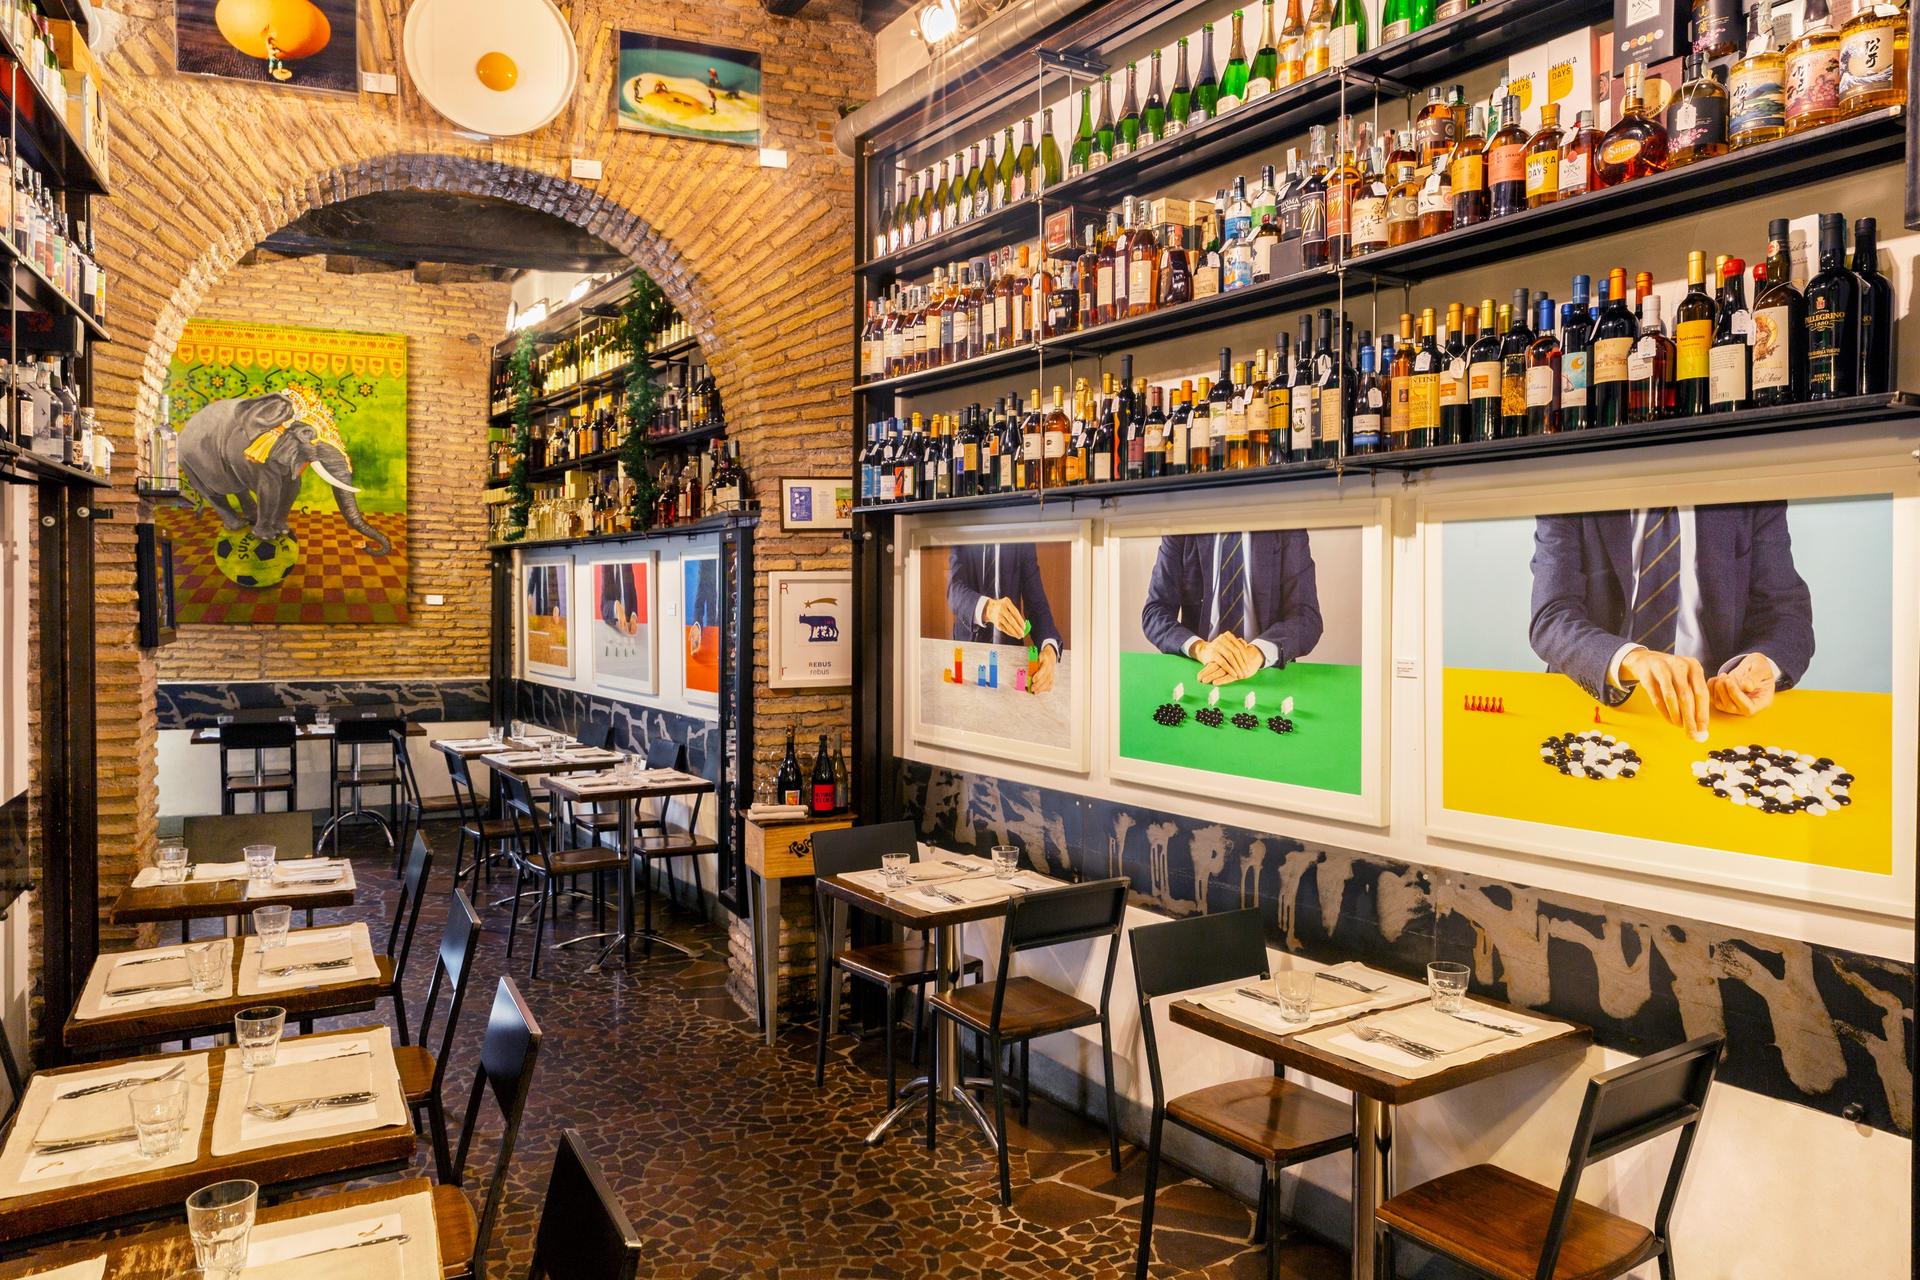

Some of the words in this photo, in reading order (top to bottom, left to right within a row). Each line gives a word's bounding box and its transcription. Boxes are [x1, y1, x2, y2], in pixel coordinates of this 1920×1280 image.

[1552, 56, 1577, 71] NIKKA
[1512, 71, 1536, 86] NIKKA
[1551, 67, 1571, 80] DAYS
[1511, 82, 1530, 94] DAYS
[1528, 155, 1556, 169] NIKKA
[1528, 167, 1548, 179] DAYS
[239, 532, 256, 560] SUPE
[780, 582, 789, 595] R
[810, 668, 830, 676] rebus
